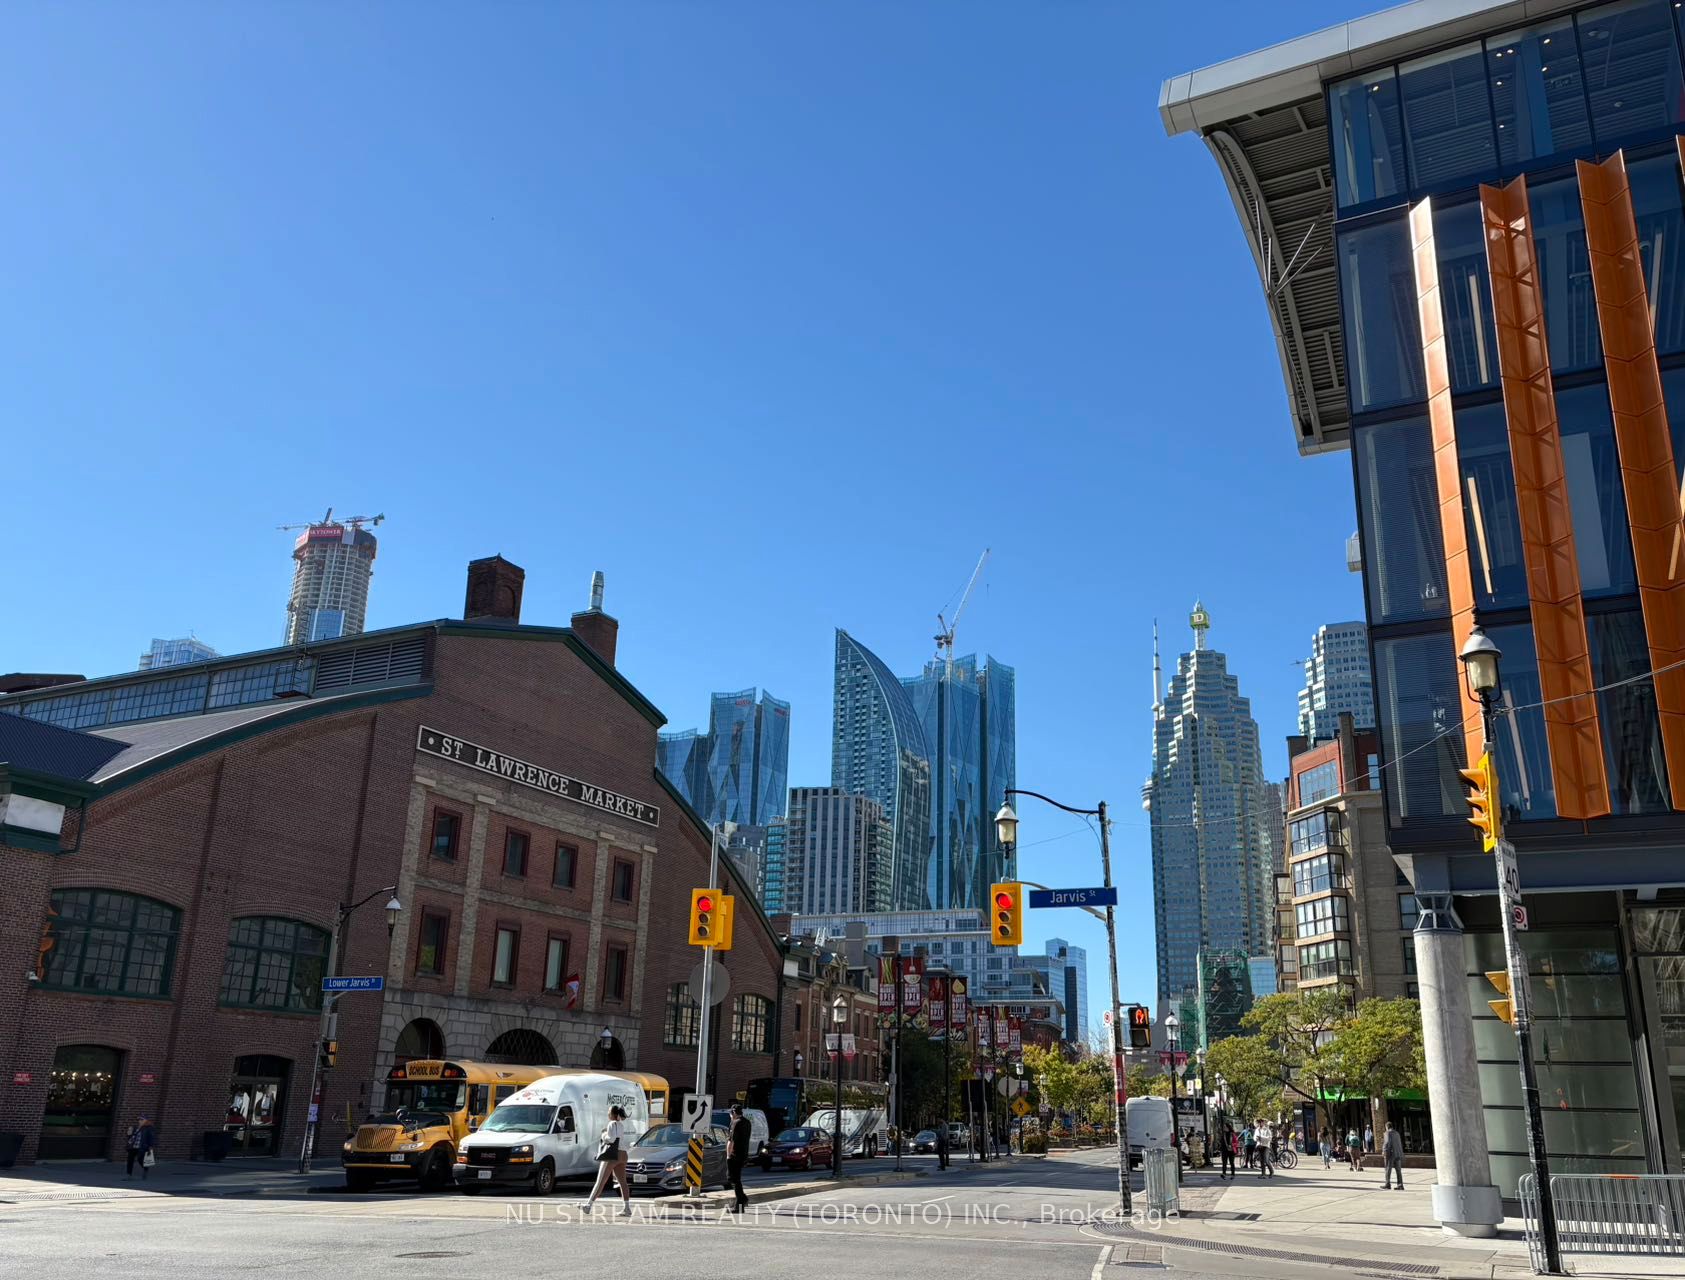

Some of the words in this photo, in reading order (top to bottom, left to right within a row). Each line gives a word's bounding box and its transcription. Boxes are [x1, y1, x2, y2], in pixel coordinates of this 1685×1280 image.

[475, 748, 569, 795] LAWRENCE
[581, 785, 644, 818] MARKET
[1506, 866, 1519, 894] 40
[1050, 889, 1086, 904] Jarvis
[329, 978, 349, 988] Lower
[349, 977, 370, 988] Jarvis
[409, 1065, 428, 1076] SCHOOL
[429, 1065, 440, 1076] BUS
